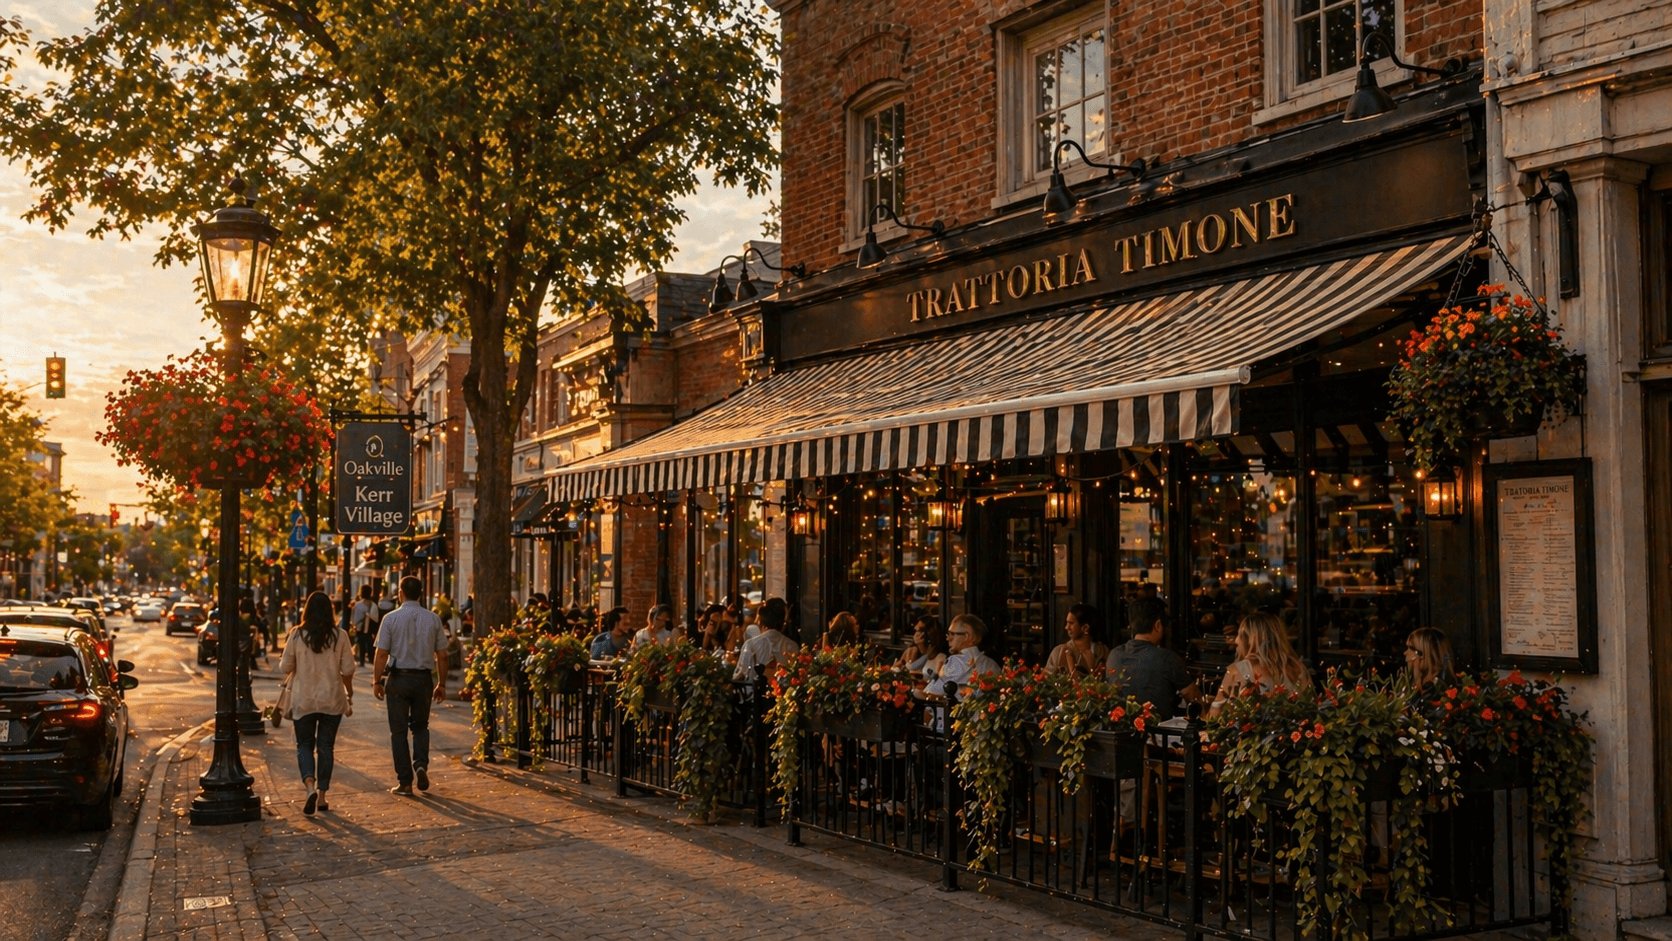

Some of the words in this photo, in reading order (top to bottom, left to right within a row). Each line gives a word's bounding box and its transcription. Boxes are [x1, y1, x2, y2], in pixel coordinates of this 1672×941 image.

[906, 248, 1096, 322] TRATTORIA
[1114, 194, 1295, 274] TIMONE
[344, 460, 404, 475] Oakville
[355, 486, 394, 502] Kerr
[344, 506, 403, 528] Village
